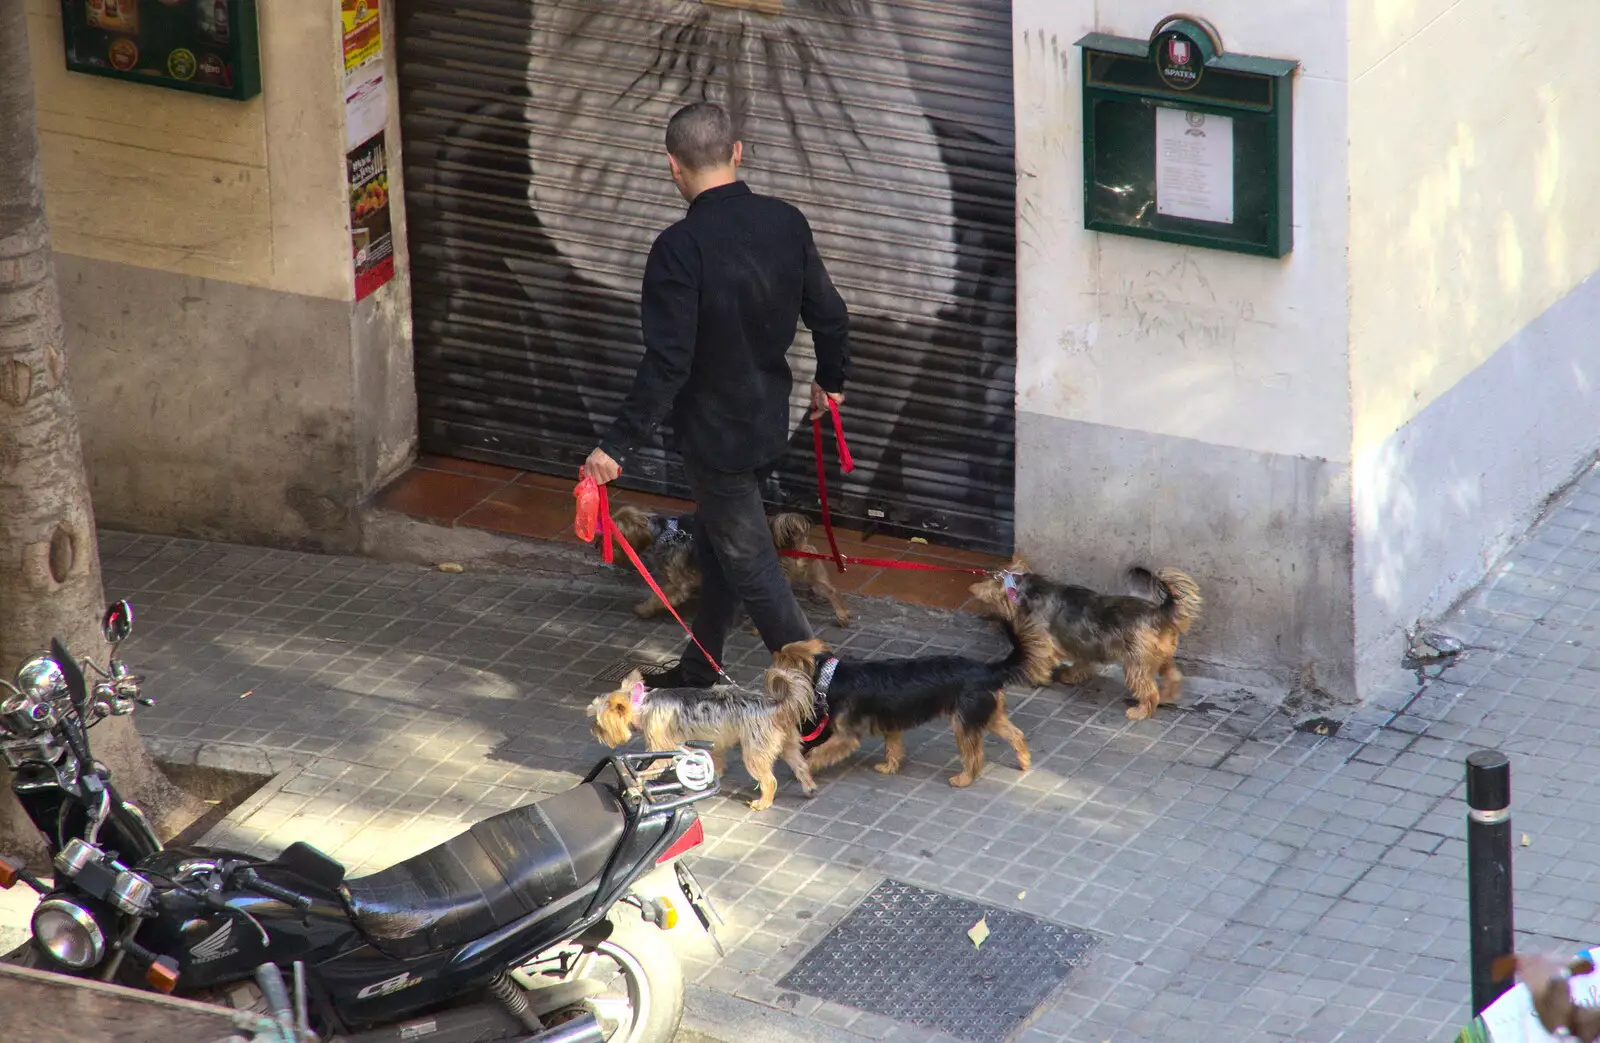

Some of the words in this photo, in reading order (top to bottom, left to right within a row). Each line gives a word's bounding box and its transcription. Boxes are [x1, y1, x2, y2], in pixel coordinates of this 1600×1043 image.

[1164, 68, 1197, 80] SPATEN
[191, 947, 239, 965] HONDA
[357, 971, 411, 999] CB
